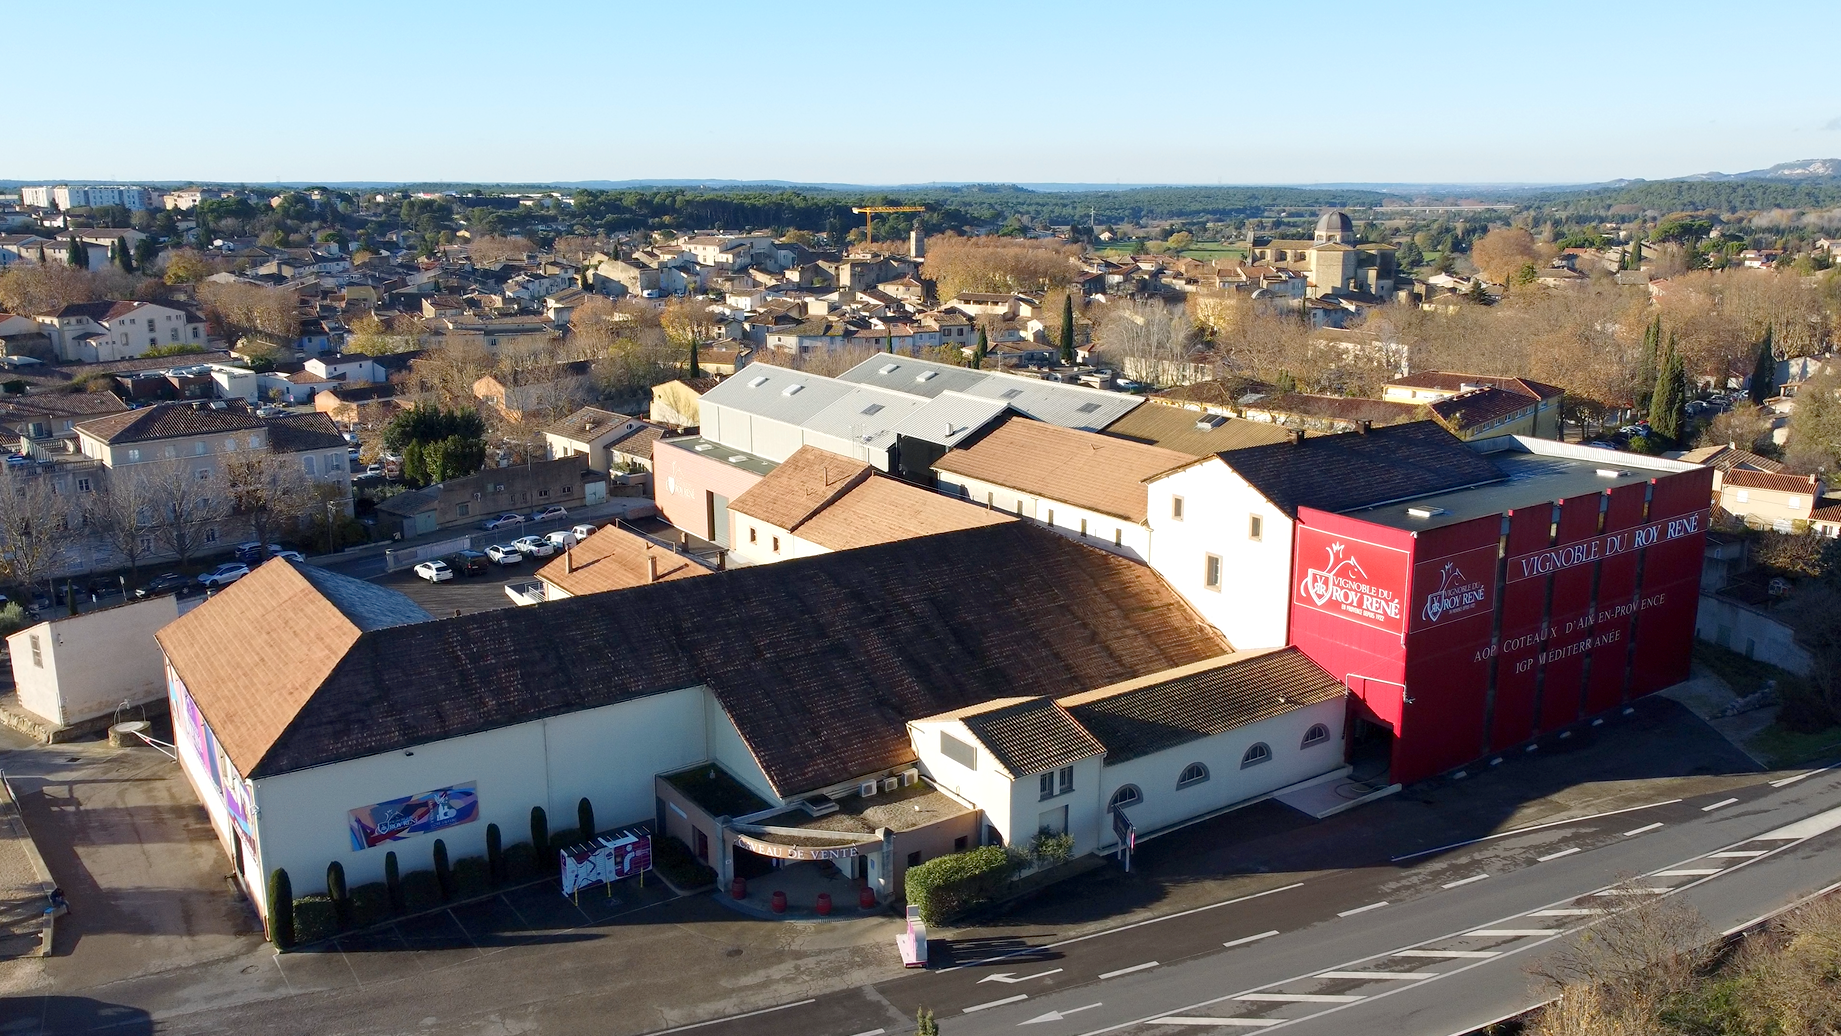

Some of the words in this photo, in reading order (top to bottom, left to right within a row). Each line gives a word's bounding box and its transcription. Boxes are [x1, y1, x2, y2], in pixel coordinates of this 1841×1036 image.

[1521, 541, 1599, 577] VIGNOBLE
[1605, 534, 1628, 555] DU
[1633, 525, 1662, 548] ROY
[1667, 513, 1699, 538] RENÉ
[1333, 577, 1377, 596] VIGNOBLE
[1378, 589, 1392, 600] DU
[1443, 595, 1462, 610] ROY
[1462, 585, 1485, 605] RENÉ
[1444, 583, 1472, 597] VIGNOBLE
[1472, 581, 1481, 590] DU
[1332, 586, 1361, 606] ROY
[1362, 598, 1400, 619] RENÉ
[1474, 645, 1497, 662] AOP
[1503, 627, 1558, 653] COTEAUX
[1515, 659, 1534, 674] IGP
[738, 839, 782, 857] CAVEAU
[788, 849, 805, 859] DE
[810, 848, 857, 860] VENTE
